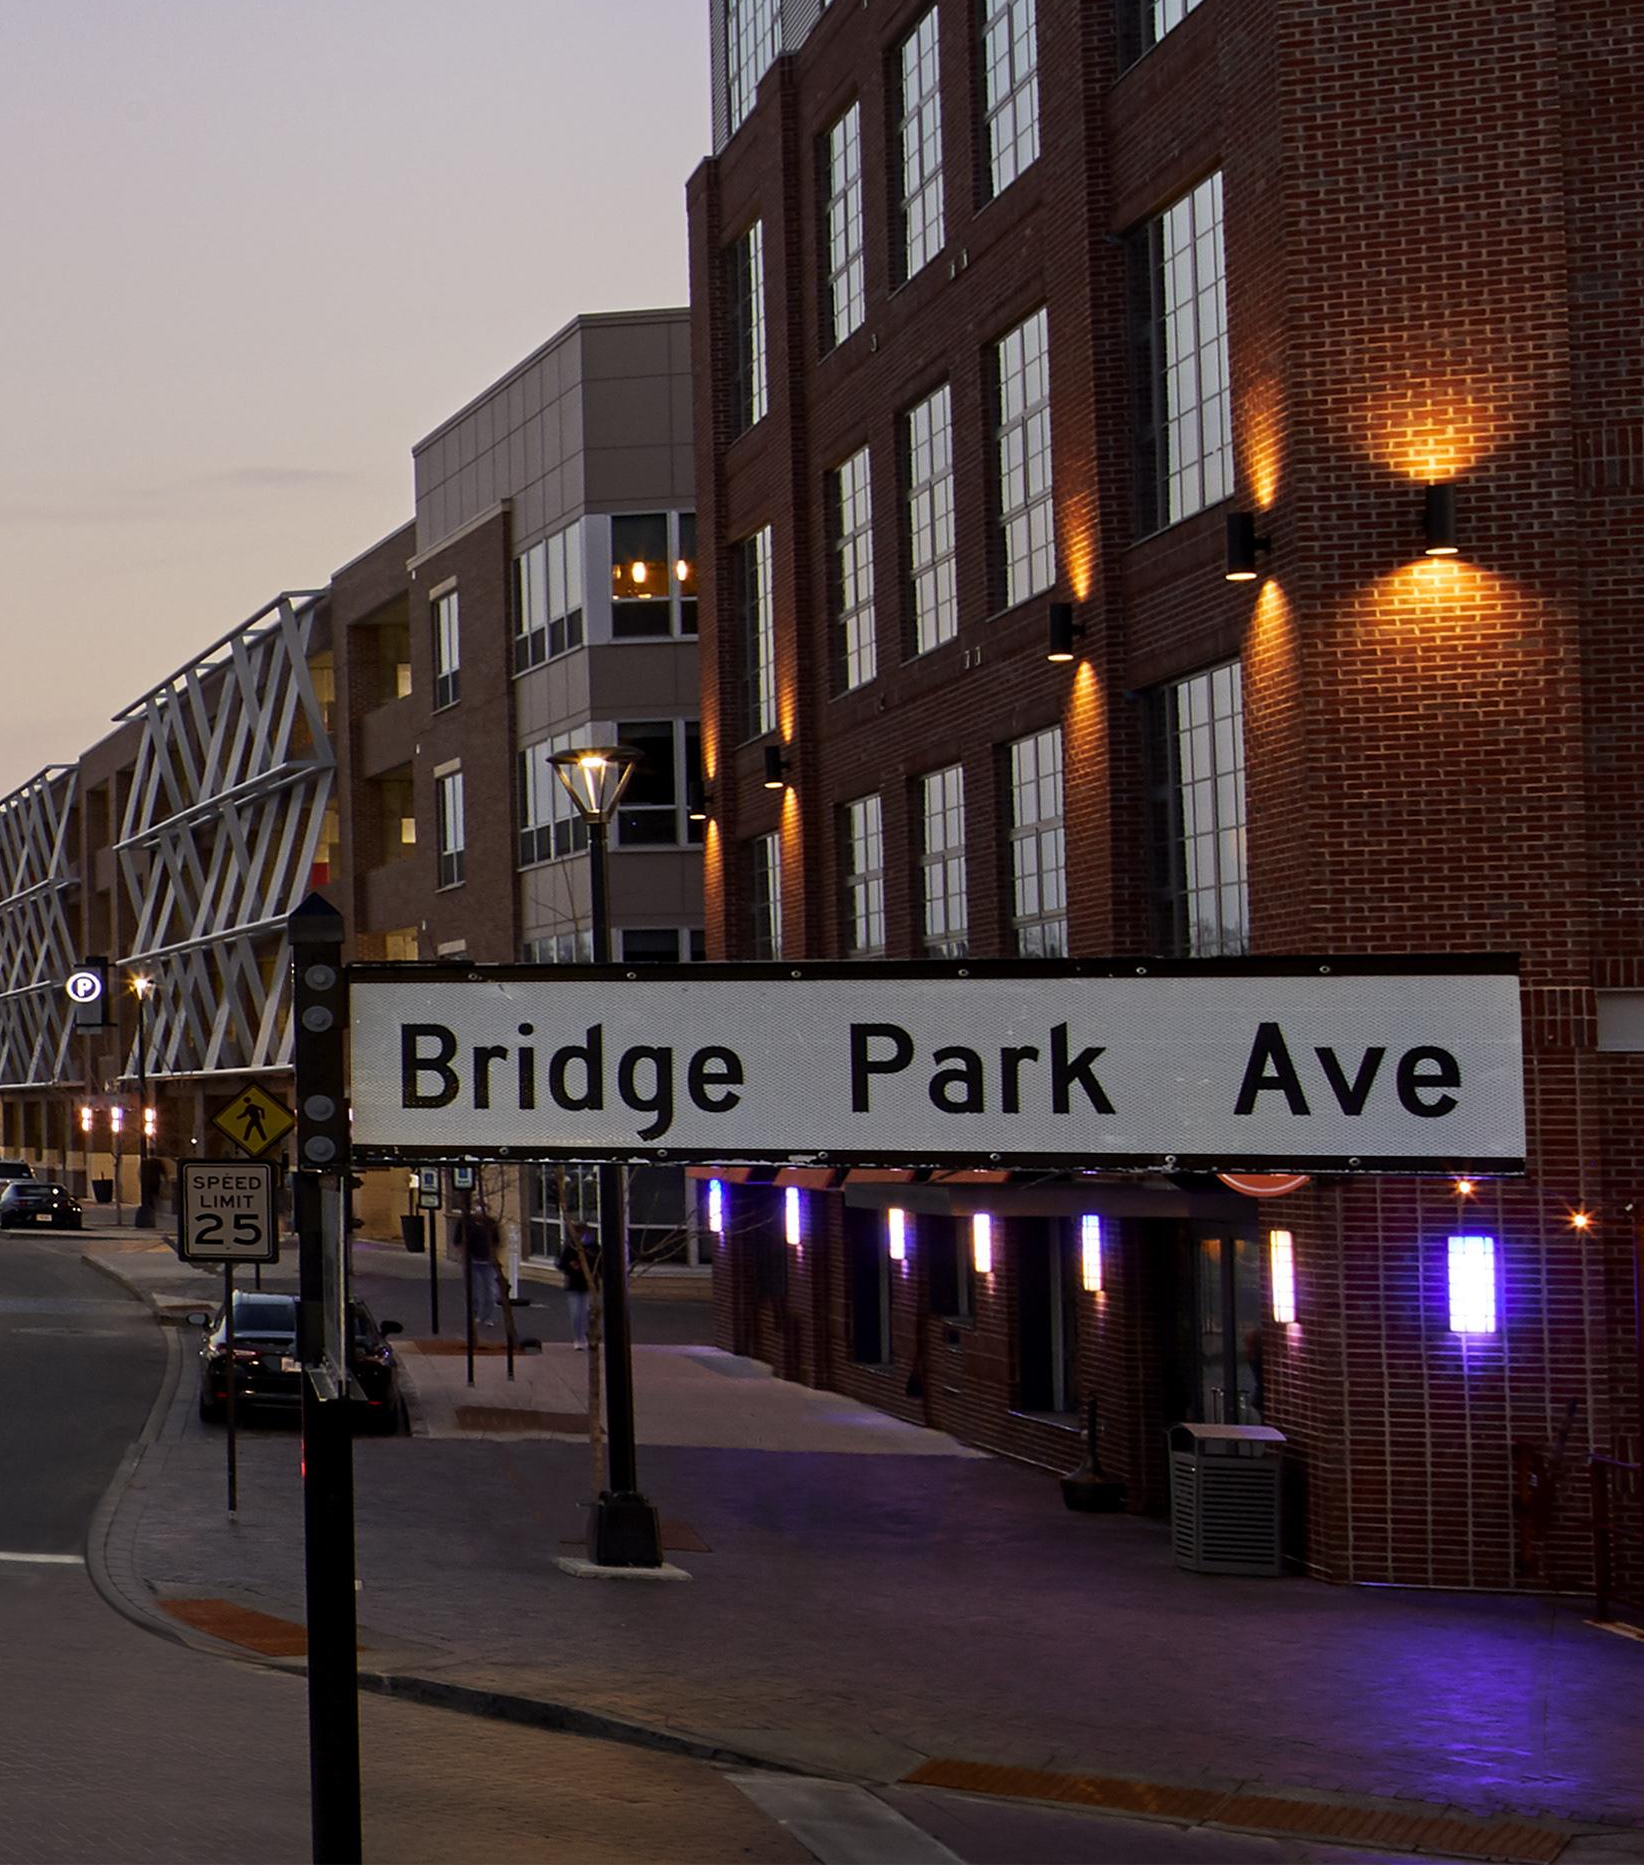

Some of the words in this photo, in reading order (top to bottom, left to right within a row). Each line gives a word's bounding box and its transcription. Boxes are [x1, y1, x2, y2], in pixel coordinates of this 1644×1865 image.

[400, 1022, 745, 1143] Bridge
[850, 1022, 1117, 1116] Park
[1233, 1021, 1463, 1119] Ave
[193, 1176, 261, 1190] SPEED
[200, 1195, 254, 1208] LIMIT
[194, 1213, 262, 1245] 25
